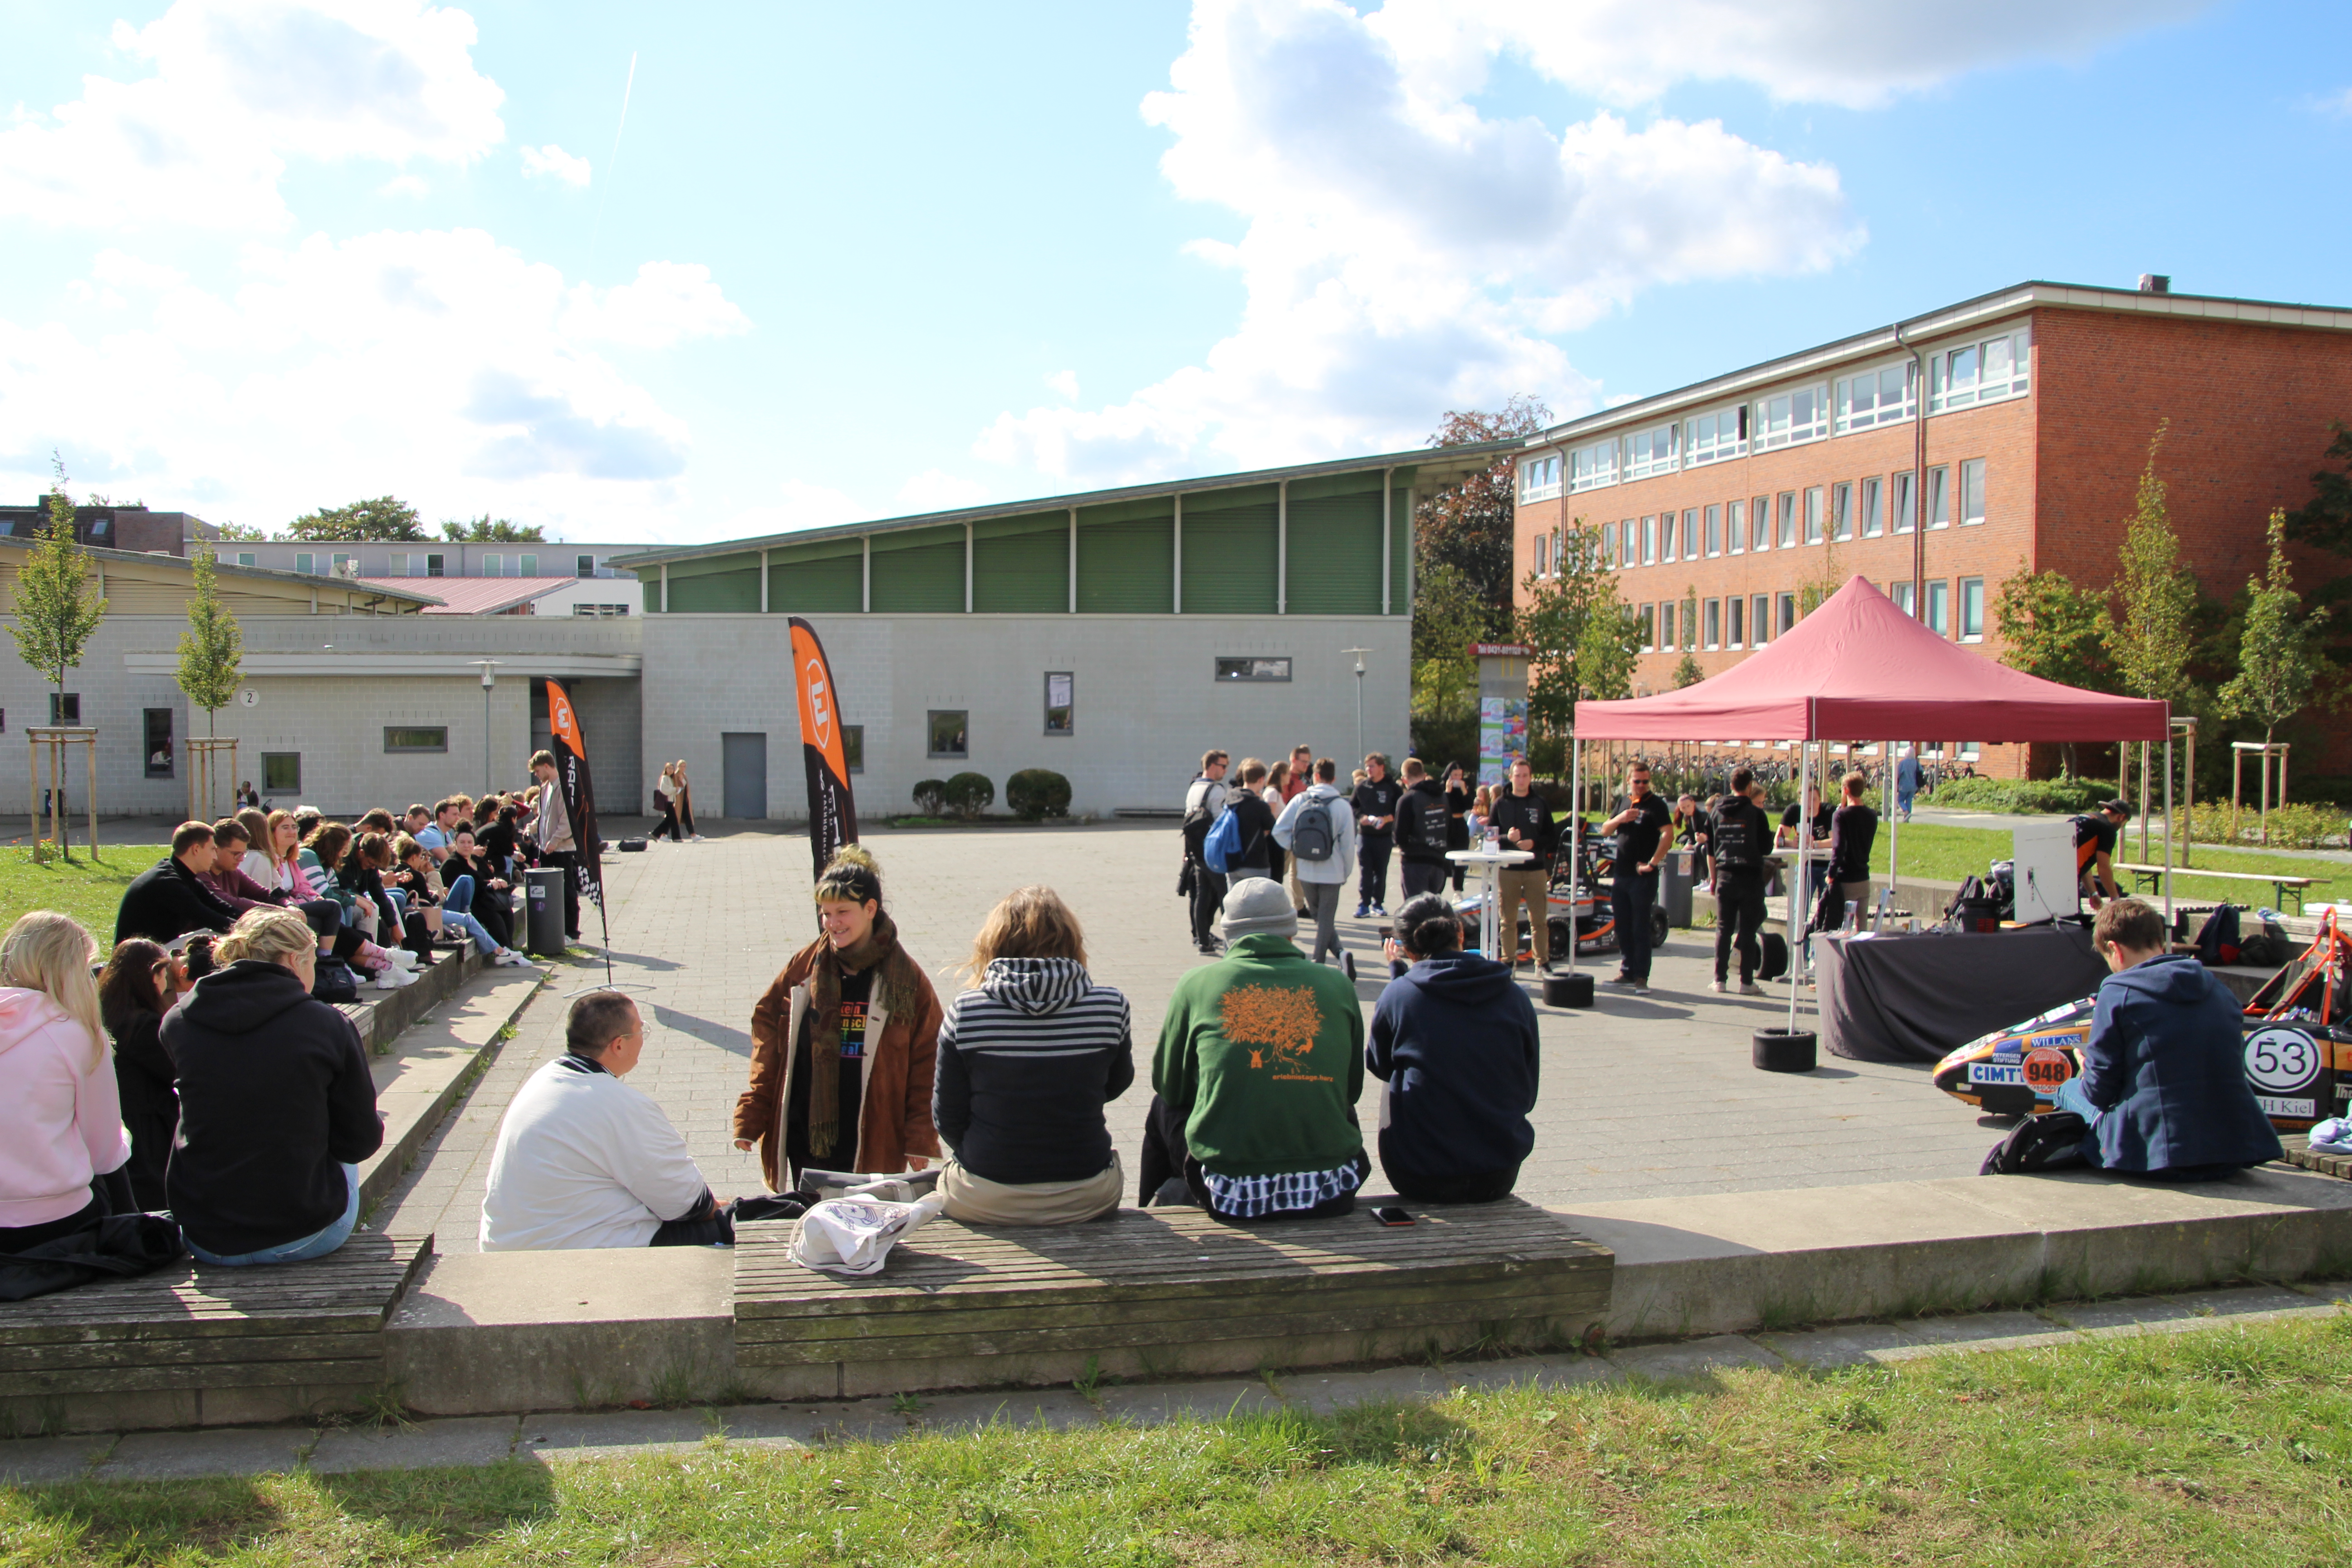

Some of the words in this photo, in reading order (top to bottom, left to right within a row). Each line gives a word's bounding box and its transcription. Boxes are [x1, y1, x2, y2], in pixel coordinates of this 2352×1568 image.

[248, 693, 252, 703] 2
[2032, 1036, 2081, 1047] WILLANS
[2254, 1041, 2306, 1075] 53
[2029, 1063, 2065, 1082] 948
[2258, 1098, 2274, 1112] H
[2281, 1101, 2312, 1114] Kiel
